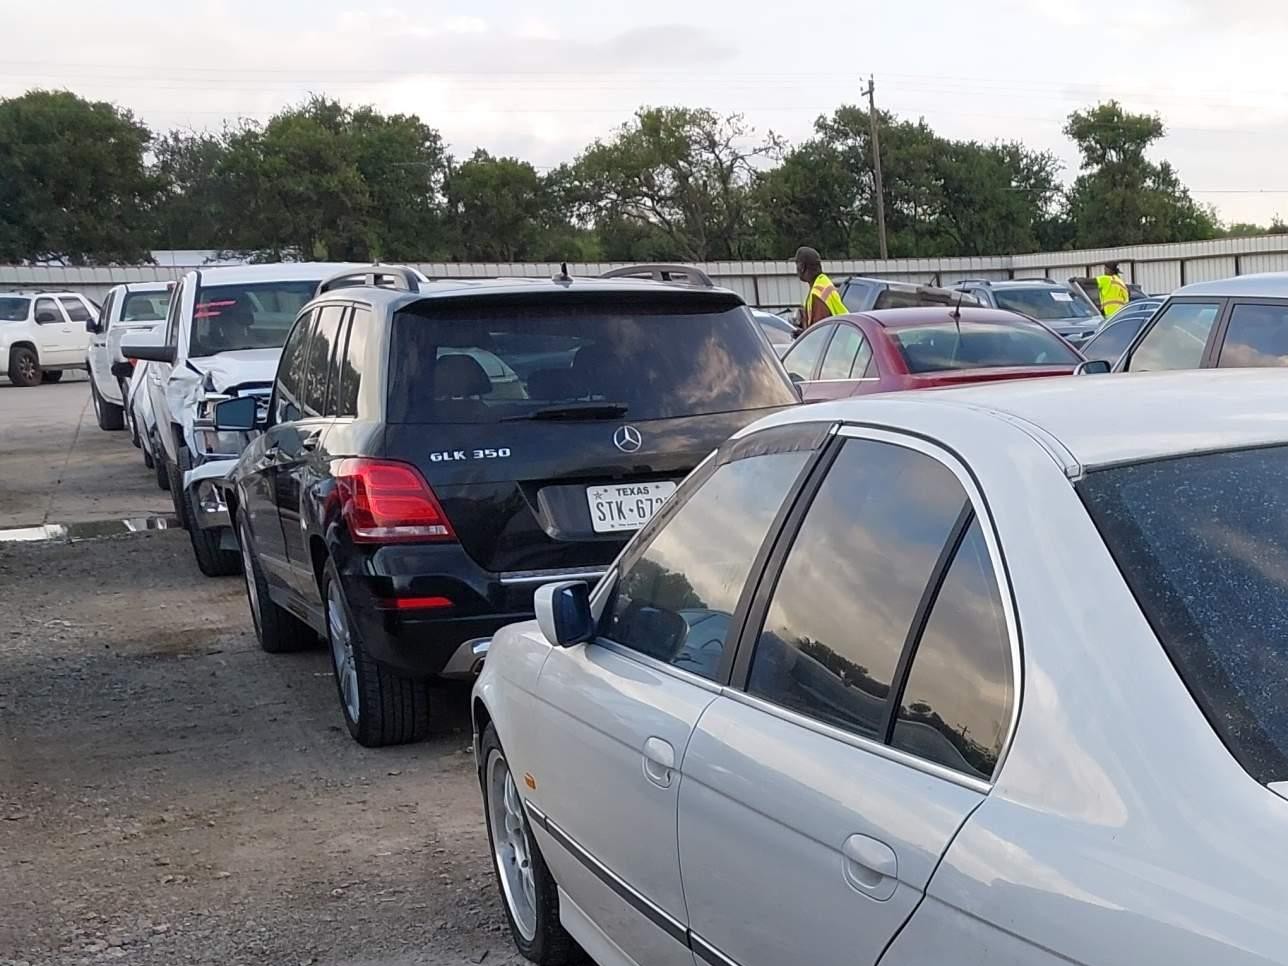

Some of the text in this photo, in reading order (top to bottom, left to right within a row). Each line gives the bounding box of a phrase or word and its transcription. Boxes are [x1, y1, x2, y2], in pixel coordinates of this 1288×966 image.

[430, 447, 512, 462] GLK 350
[616, 486, 650, 497] TEXAS
